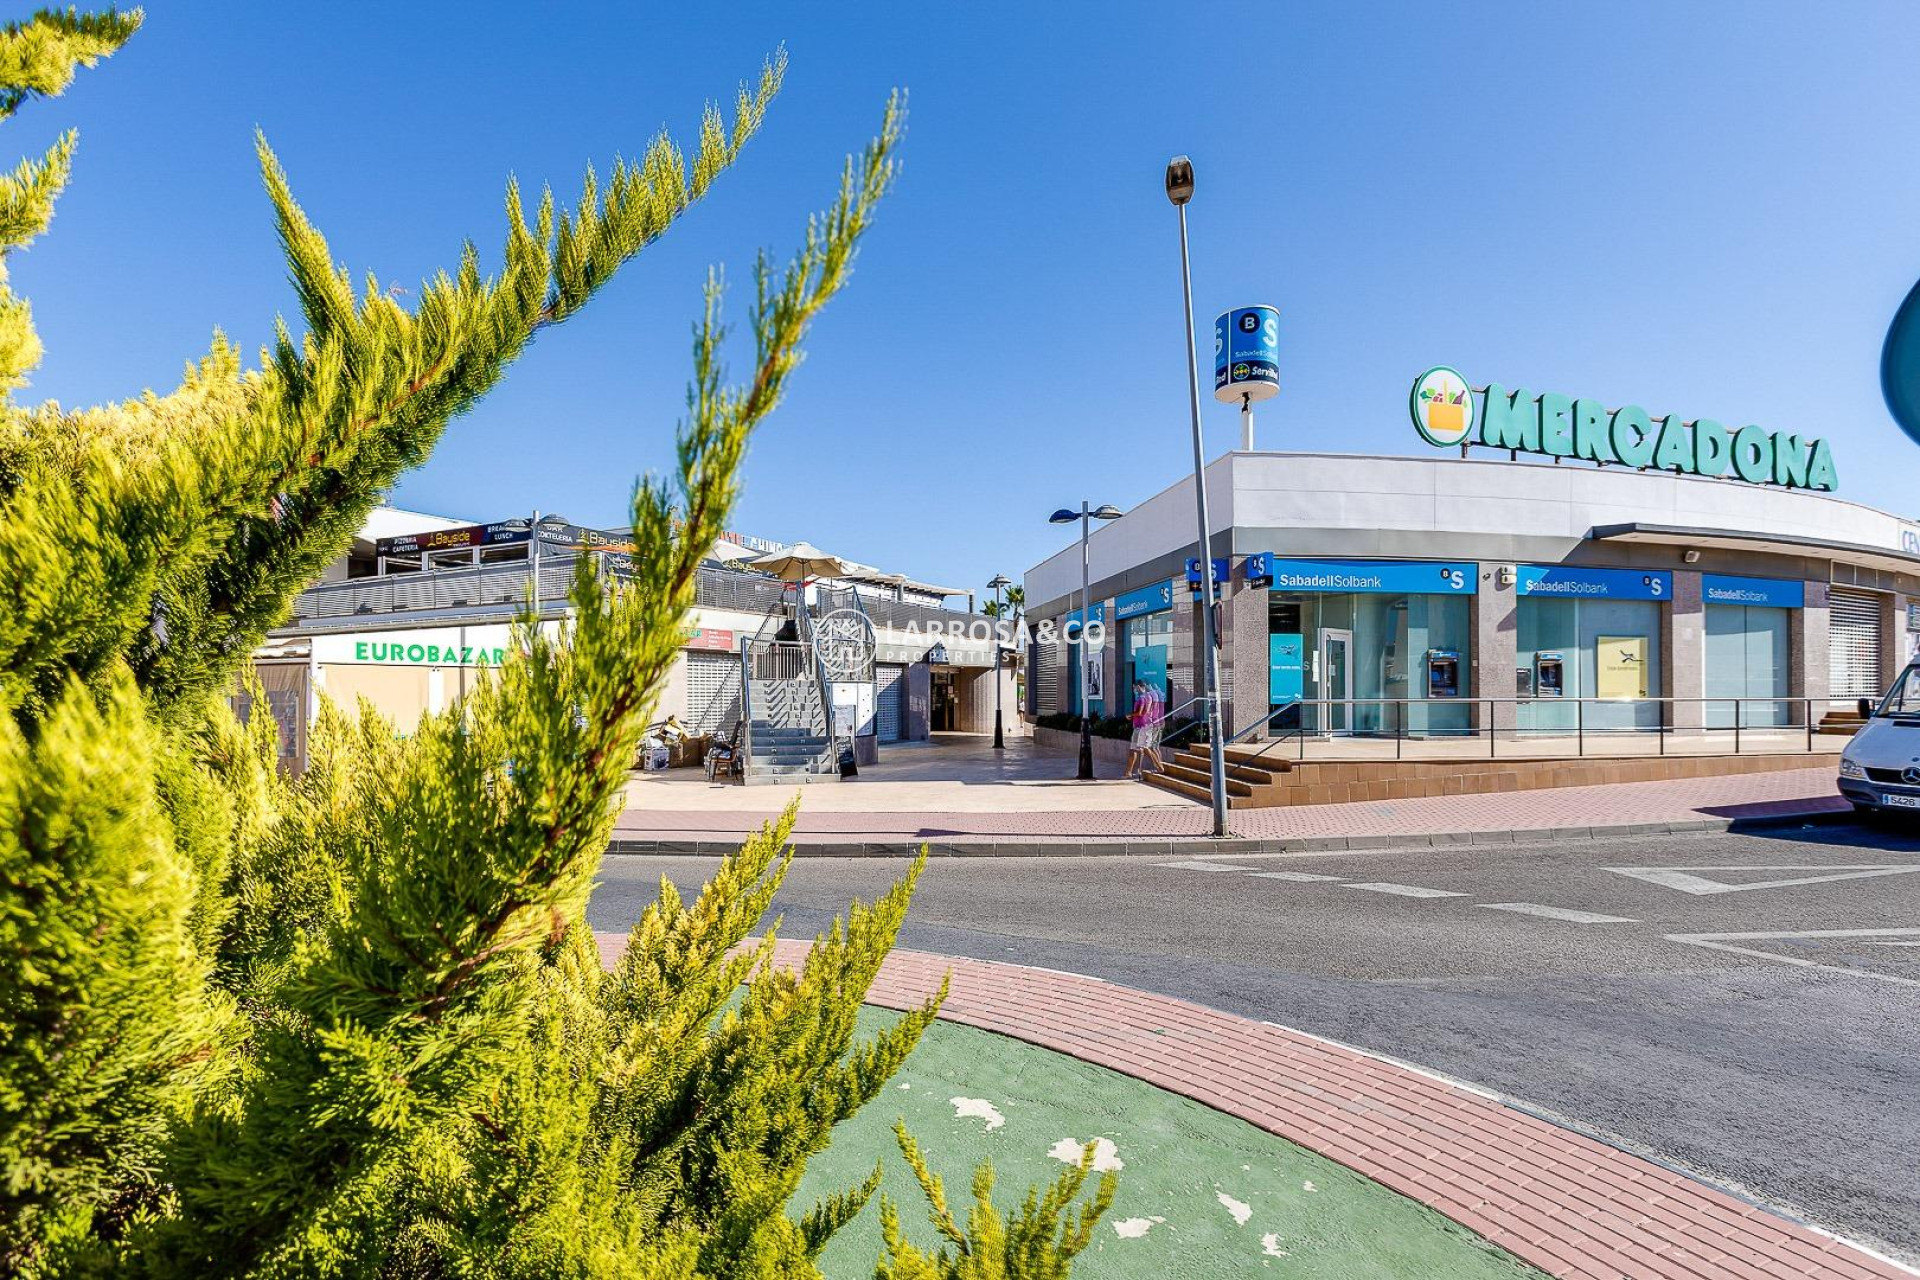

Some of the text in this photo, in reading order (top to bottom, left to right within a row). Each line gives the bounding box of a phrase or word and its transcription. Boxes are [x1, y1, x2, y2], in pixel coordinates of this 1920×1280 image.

[1244, 317, 1256, 329] B
[1479, 383, 1838, 492] MERCADONA
[436, 531, 470, 546] Bayside
[494, 532, 513, 540] LUNCH
[1450, 571, 1465, 589] S
[1651, 579, 1662, 596] S
[355, 642, 505, 665] EUROBAZAR
